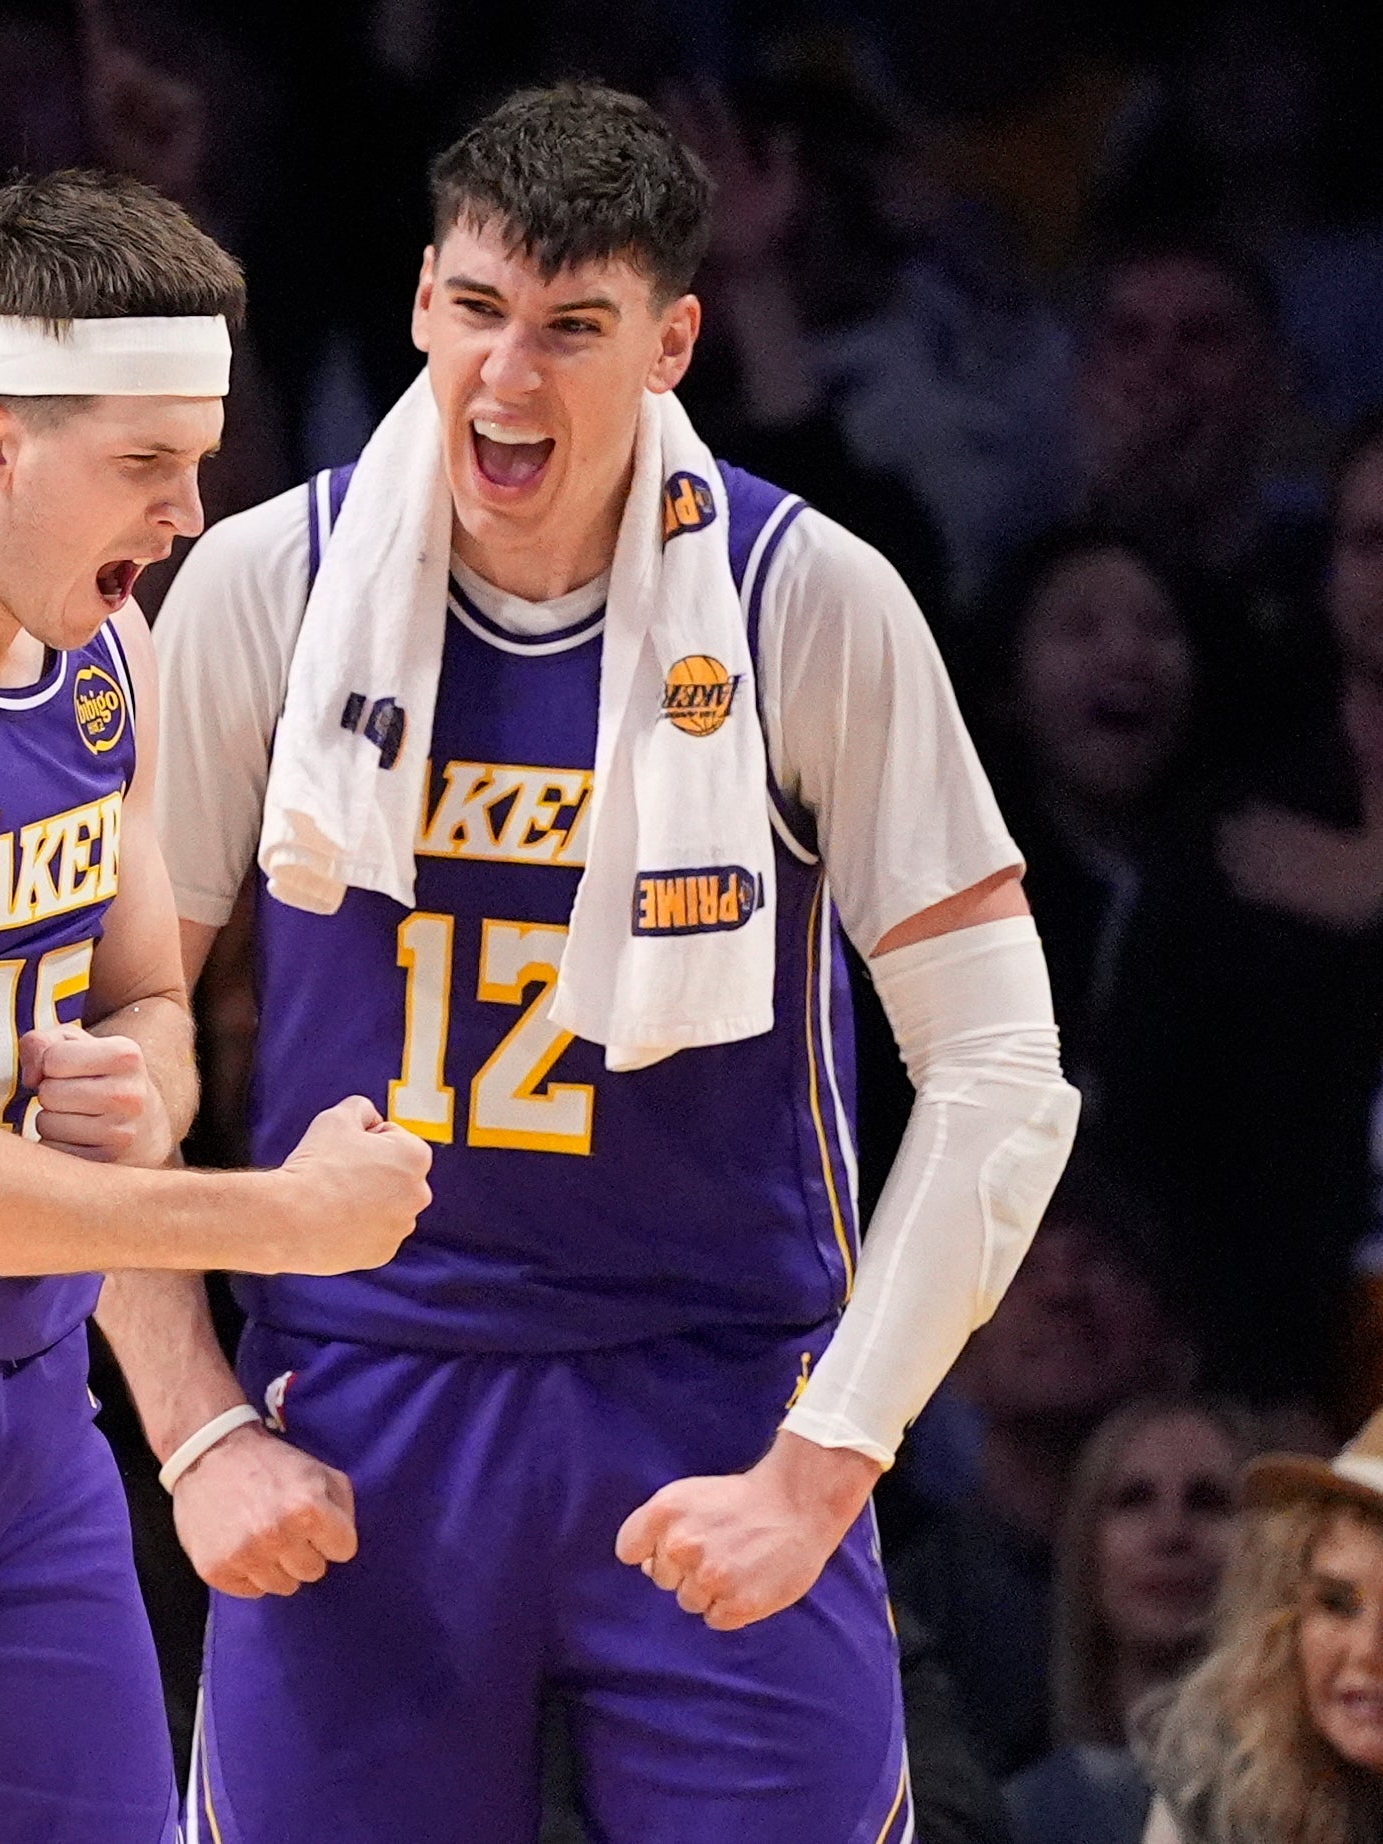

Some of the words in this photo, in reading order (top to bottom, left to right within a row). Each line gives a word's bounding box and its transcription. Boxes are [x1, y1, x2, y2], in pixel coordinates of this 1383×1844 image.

[77, 690, 119, 723] bibigo
[638, 872, 739, 929] PRIME
[387, 911, 596, 1157] 12
